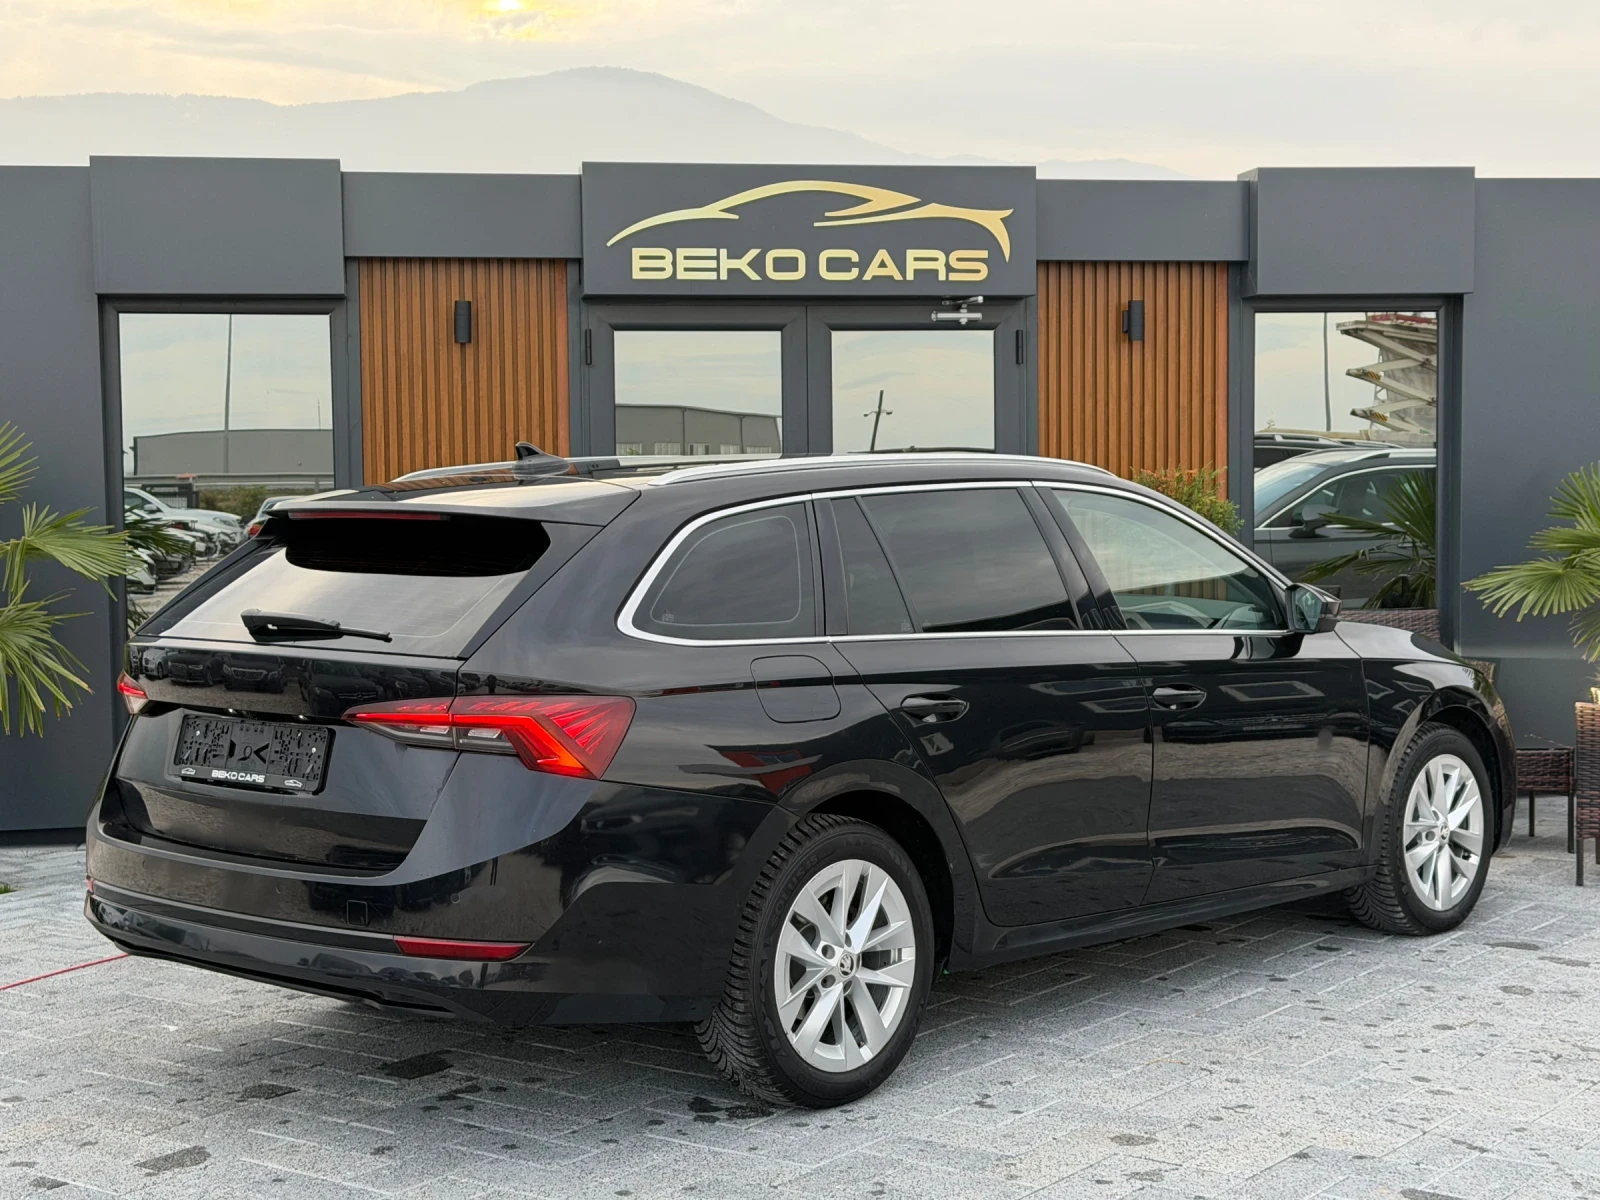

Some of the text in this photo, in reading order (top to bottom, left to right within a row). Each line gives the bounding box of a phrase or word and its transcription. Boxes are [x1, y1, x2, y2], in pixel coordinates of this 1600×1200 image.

[631, 247, 989, 281] BEKO CARS
[211, 769, 265, 783] BEKO CARS
